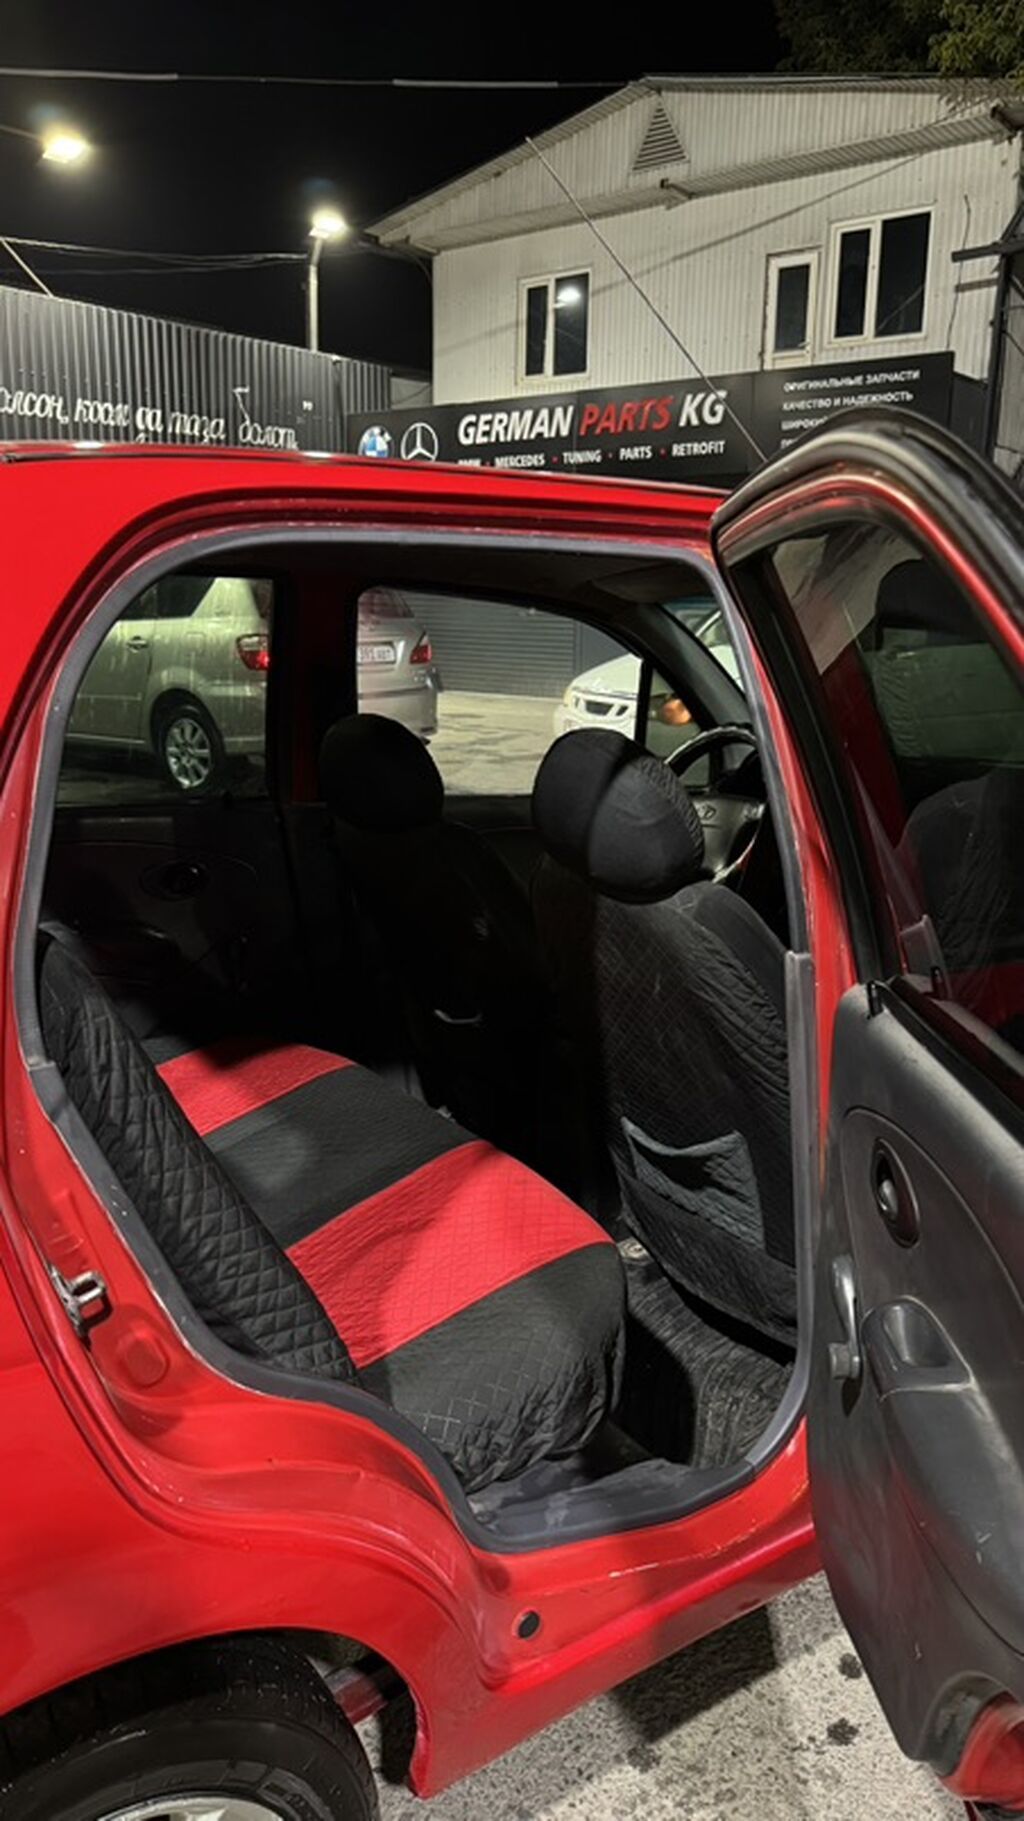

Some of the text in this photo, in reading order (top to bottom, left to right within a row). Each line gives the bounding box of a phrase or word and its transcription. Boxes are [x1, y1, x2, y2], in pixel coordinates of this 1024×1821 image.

[783, 369, 920, 392] ОРИГИНАЛЬНЫЕ ЗАПЧАСТИ
[782, 397, 832, 411] КАЧЕСТВО
[833, 397, 841, 406] И
[458, 390, 728, 446] GERMAN PARTS KG
[494, 453, 546, 468] MERCEDES
[562, 449, 603, 465] TUNING
[619, 445, 653, 460] PARTS
[671, 440, 727, 458] RETROFIT
